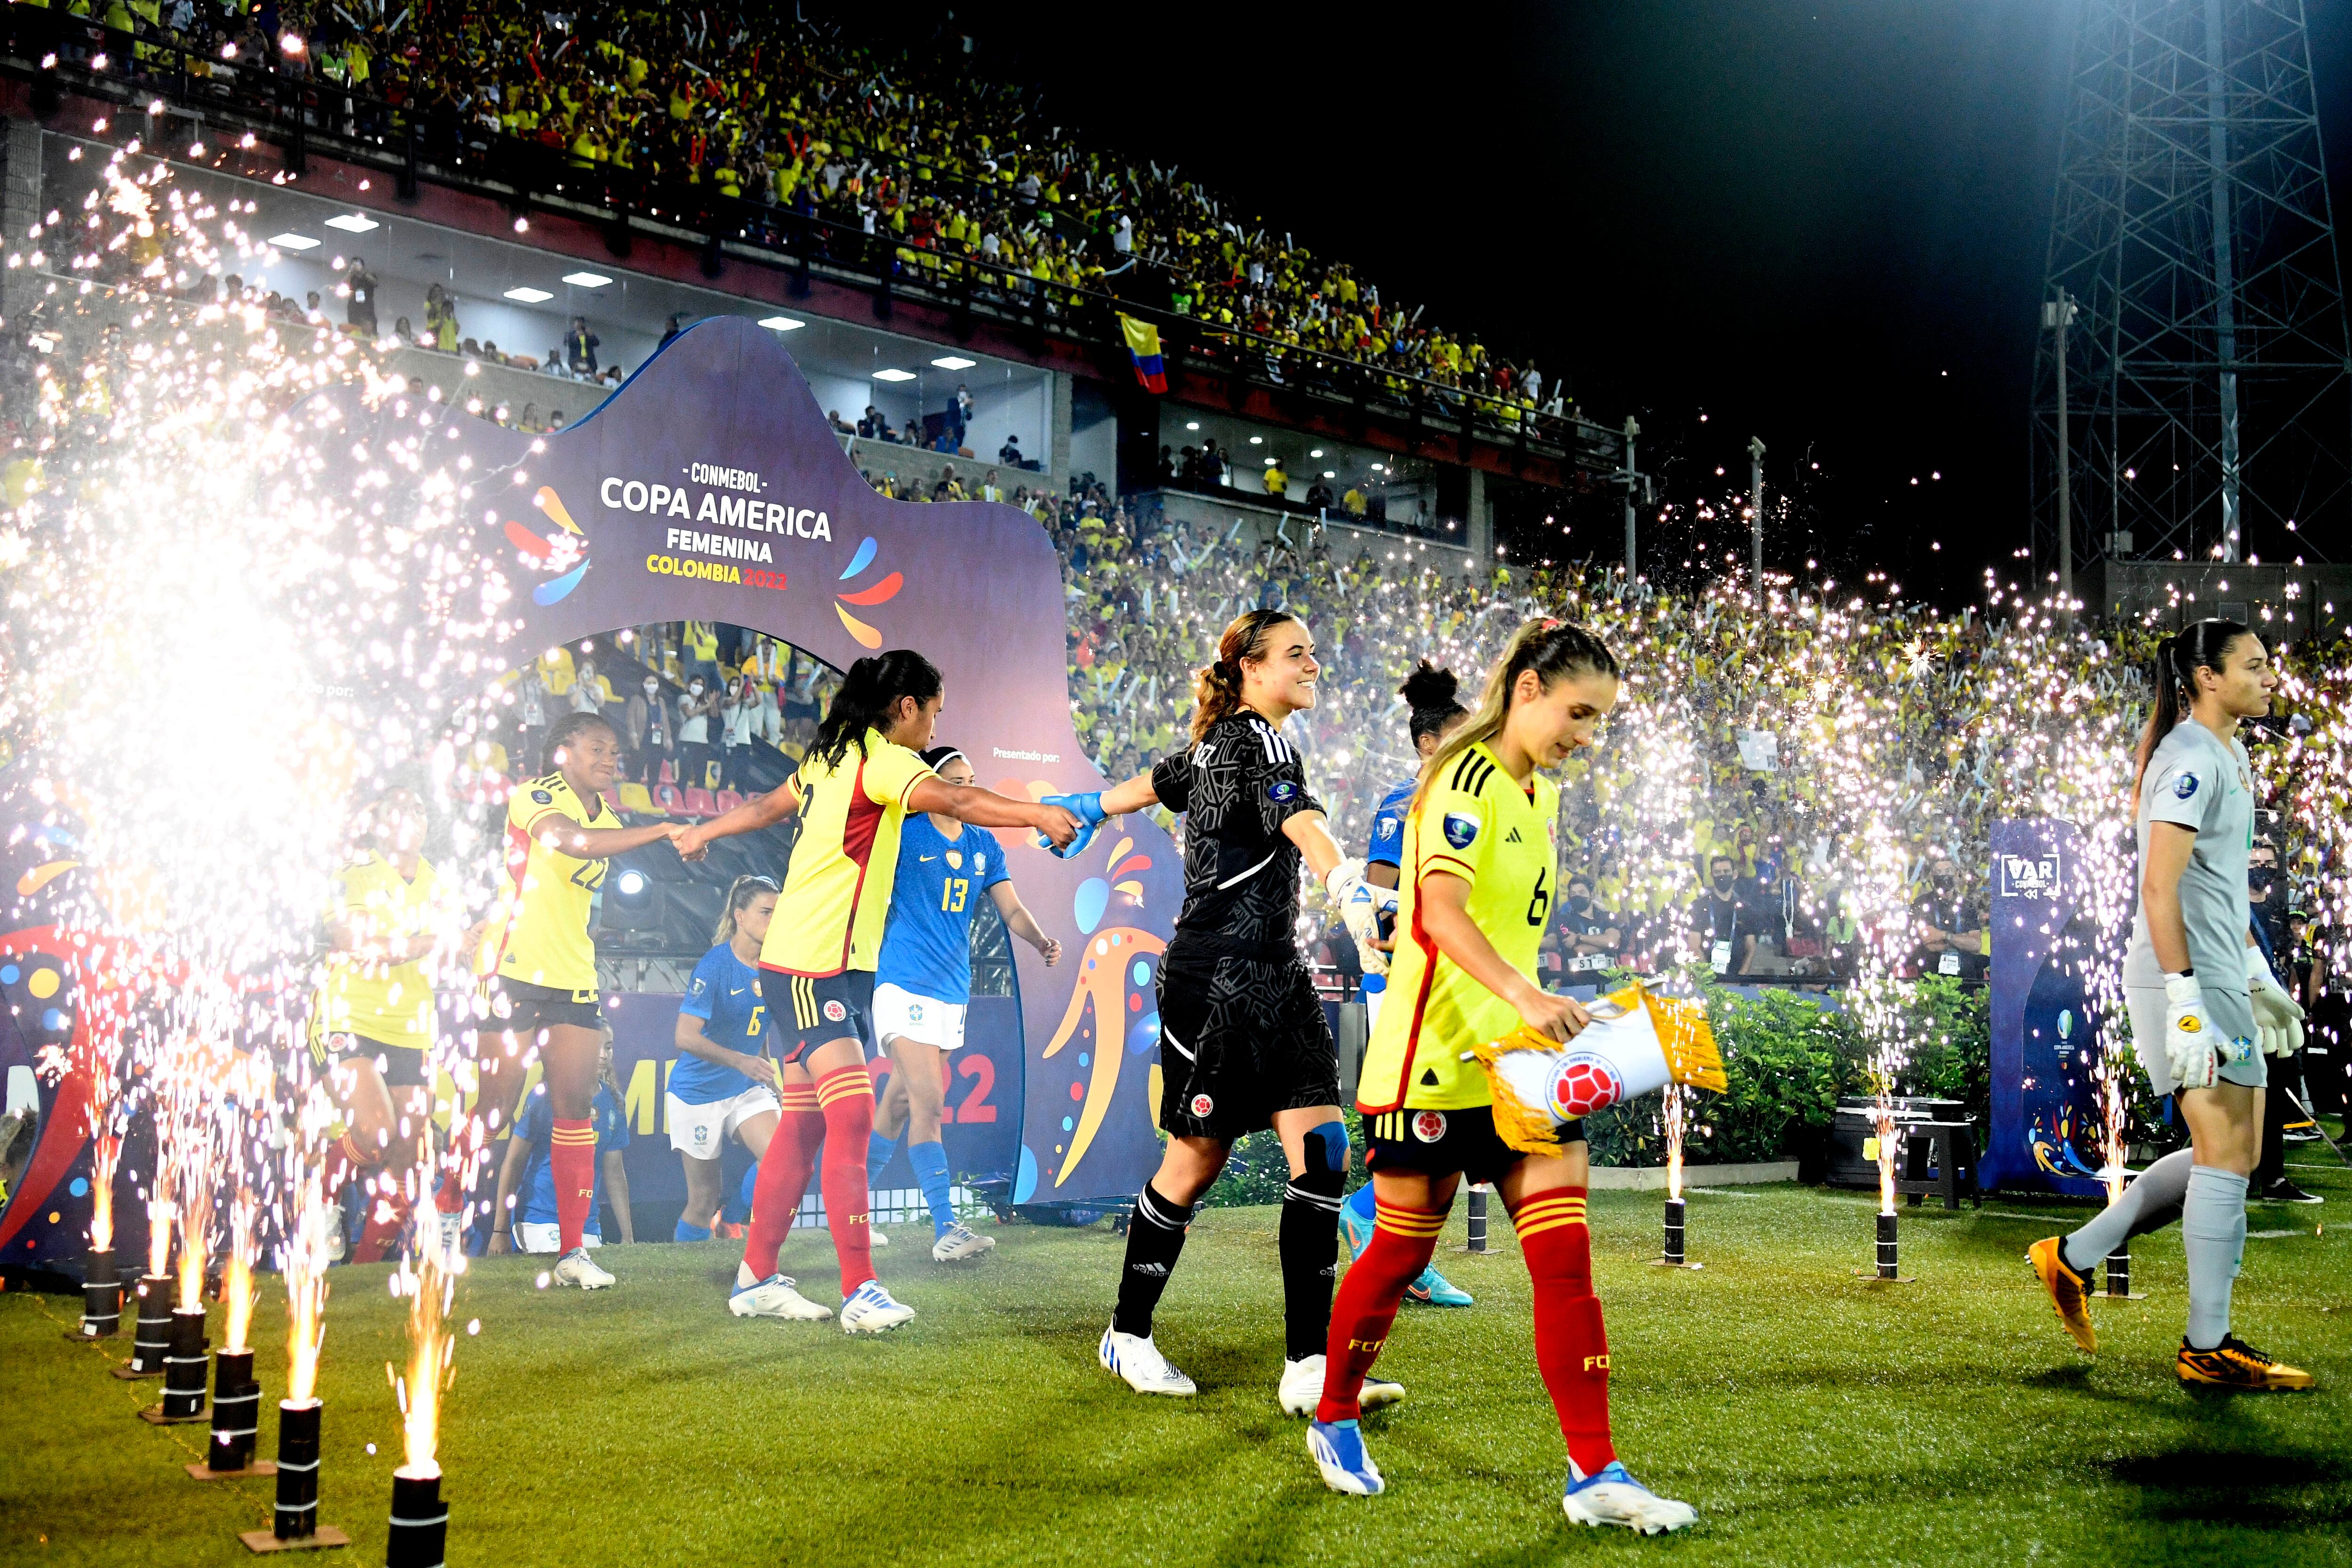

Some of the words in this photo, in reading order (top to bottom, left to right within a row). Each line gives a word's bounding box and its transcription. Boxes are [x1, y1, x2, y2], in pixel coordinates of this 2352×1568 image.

[601, 477, 691, 519] COPA
[696, 492, 832, 542] AMERICA
[667, 527, 773, 564] FEMENINA
[646, 554, 741, 584] COLOMBIA
[743, 568, 788, 590] 2022
[993, 747, 1041, 761] Presentado
[1042, 753, 1060, 764] por:
[2007, 859, 2053, 879] VAR
[941, 877, 969, 912] 13
[1526, 866, 1548, 926] 6
[747, 1006, 765, 1035] 6
